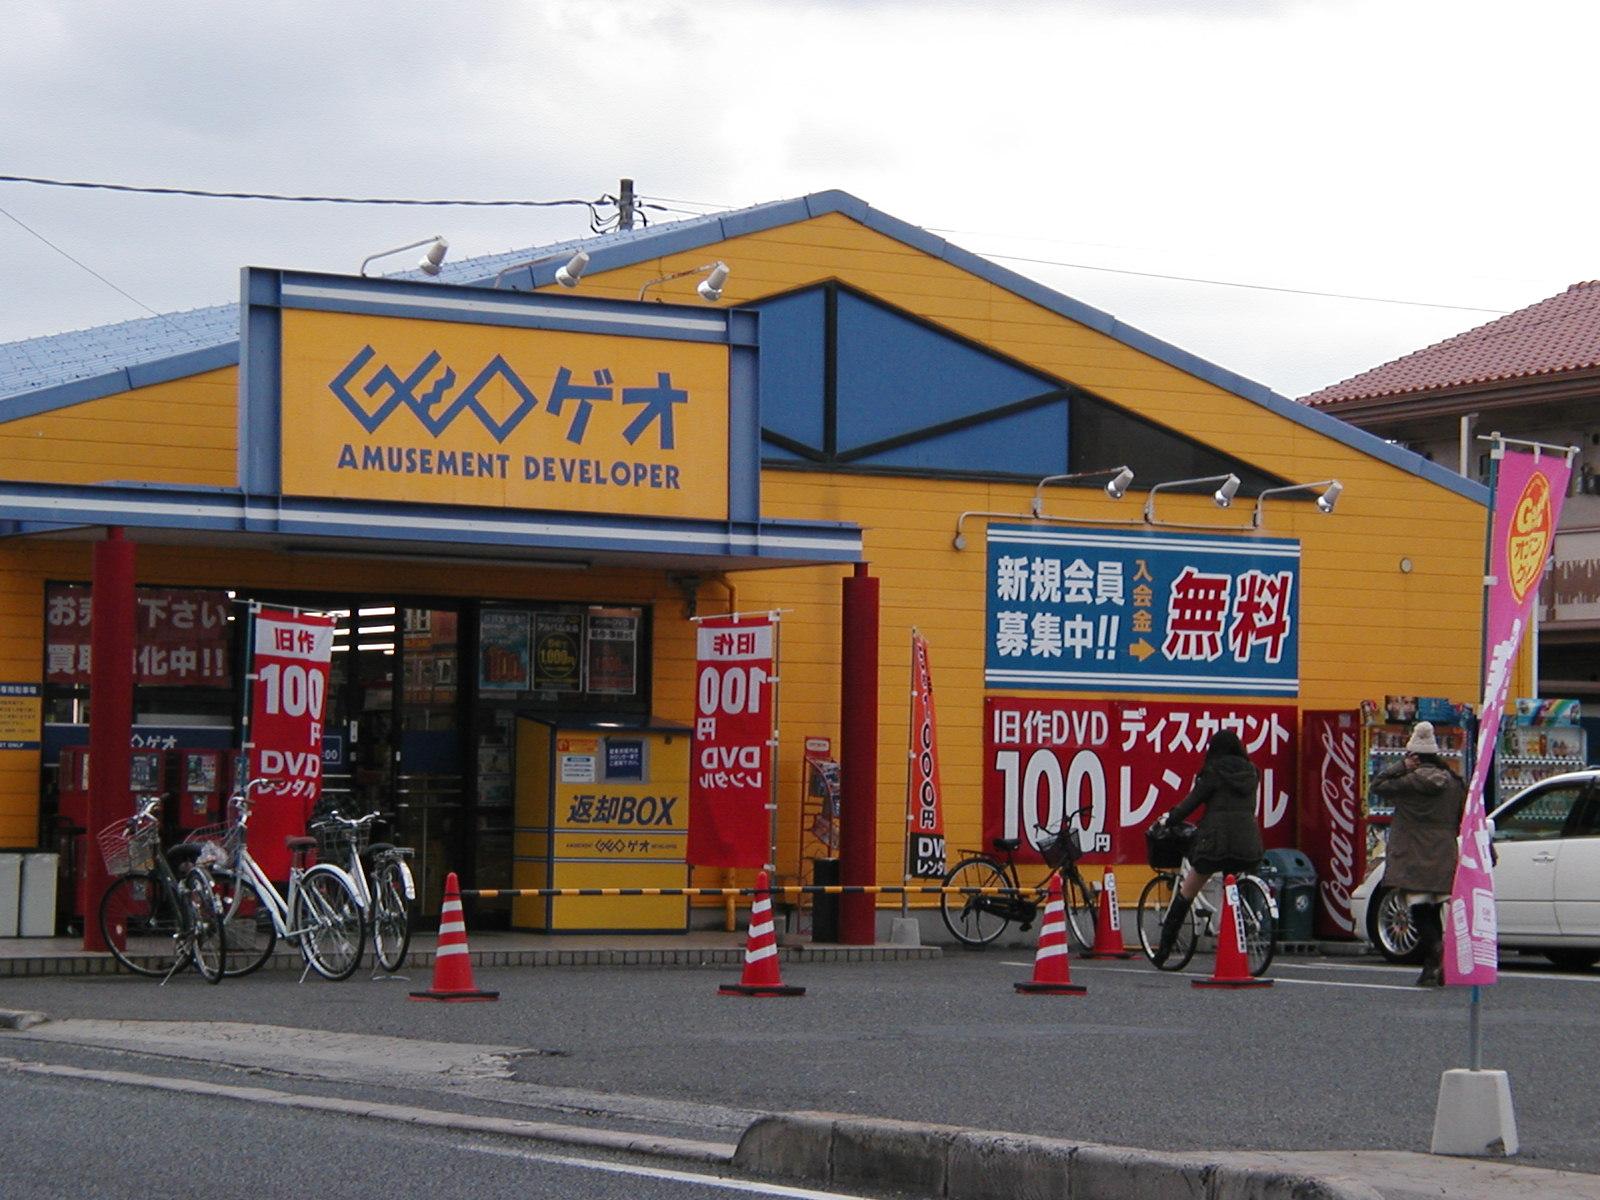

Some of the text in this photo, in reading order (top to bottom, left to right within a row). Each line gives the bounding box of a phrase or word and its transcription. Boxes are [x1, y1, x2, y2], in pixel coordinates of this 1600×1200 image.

[546, 366, 689, 450] ゲオ
[337, 444, 681, 490] AMUSEMENT DEVELOPER
[997, 555, 1125, 606] 新規会員
[1131, 559, 1154, 633] 入会金
[49, 596, 228, 630] お下さい
[1162, 565, 1293, 664] 無料
[48, 645, 225, 678] 買化中!!
[274, 627, 315, 654] 旧作
[259, 663, 325, 721] 100
[993, 708, 1110, 746] 旧作DVD
[260, 750, 321, 778] DVD
[566, 794, 678, 826] 返却BOX
